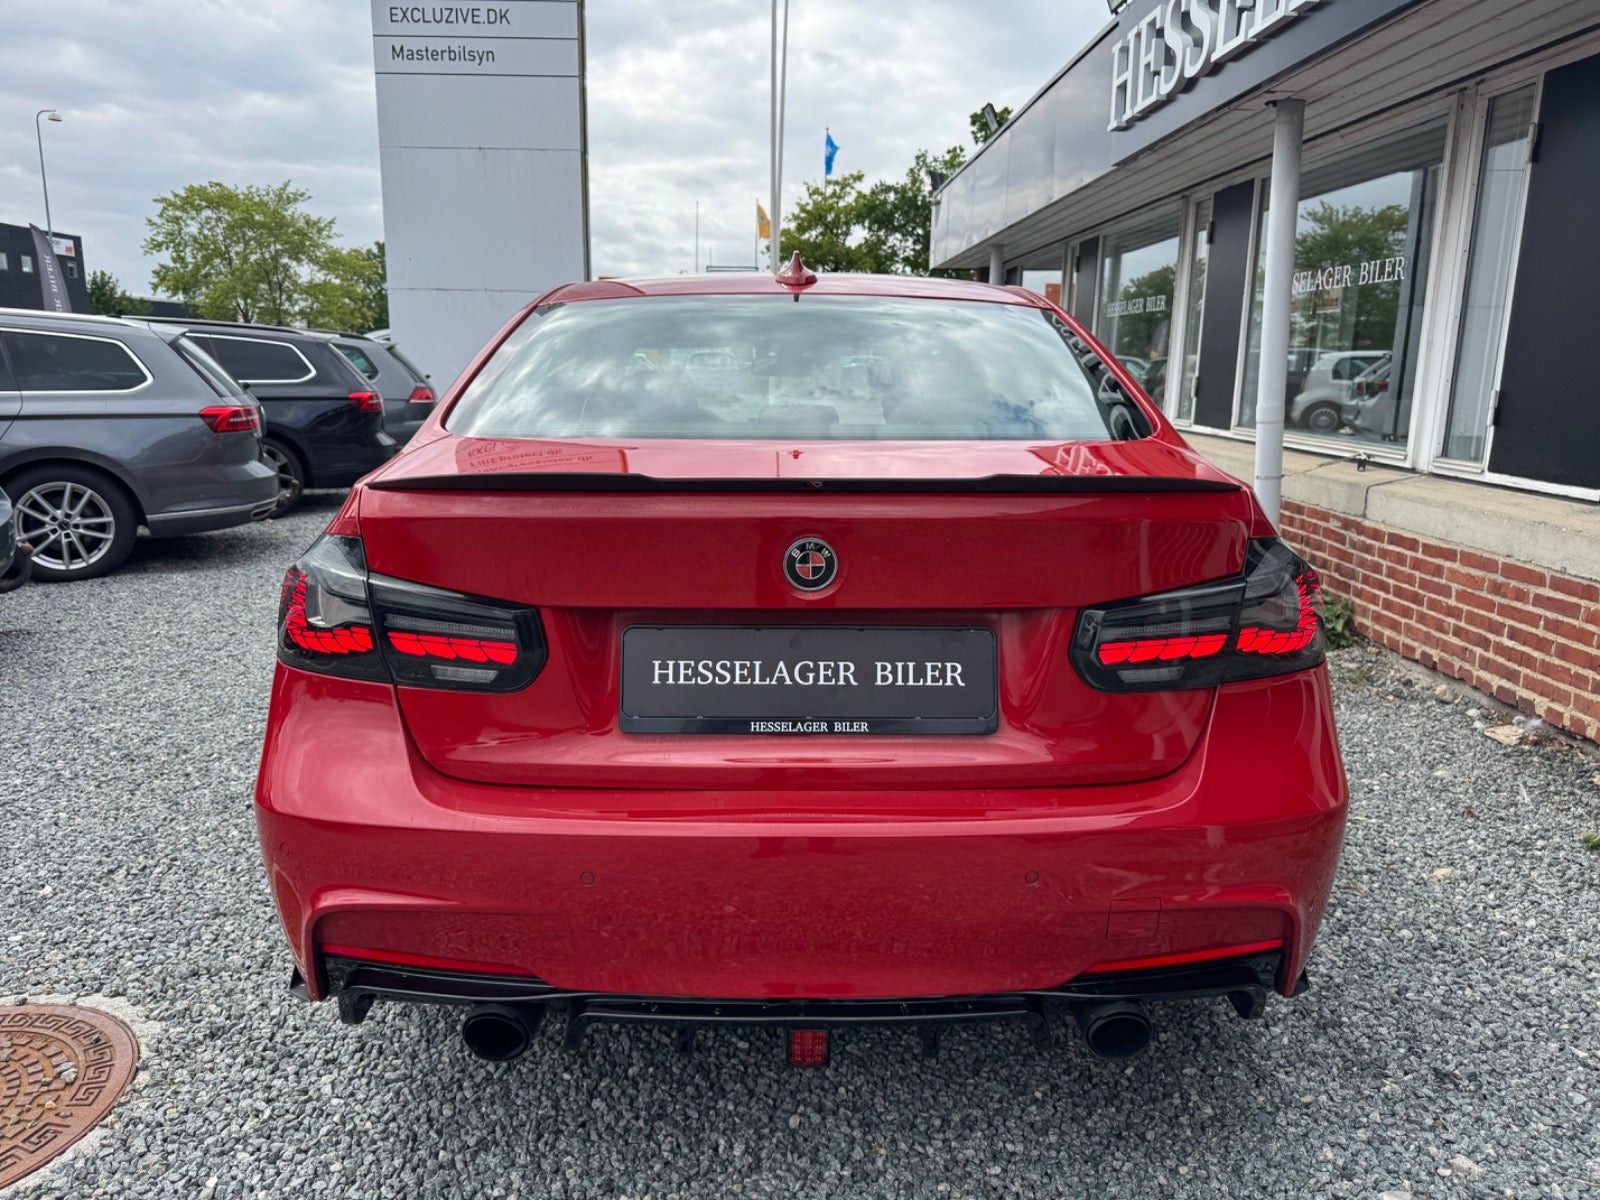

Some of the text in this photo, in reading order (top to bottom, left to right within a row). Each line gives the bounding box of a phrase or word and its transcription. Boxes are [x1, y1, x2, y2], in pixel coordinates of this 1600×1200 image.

[389, 7, 511, 25] EXCLUZIVE.DK
[391, 45, 495, 66] Masterbilsyn
[1358, 257, 1405, 286] BILER
[791, 542, 831, 558] BMW
[652, 660, 966, 686] HESSELAGER BILER
[750, 721, 869, 732] HESSELAGER BILER
